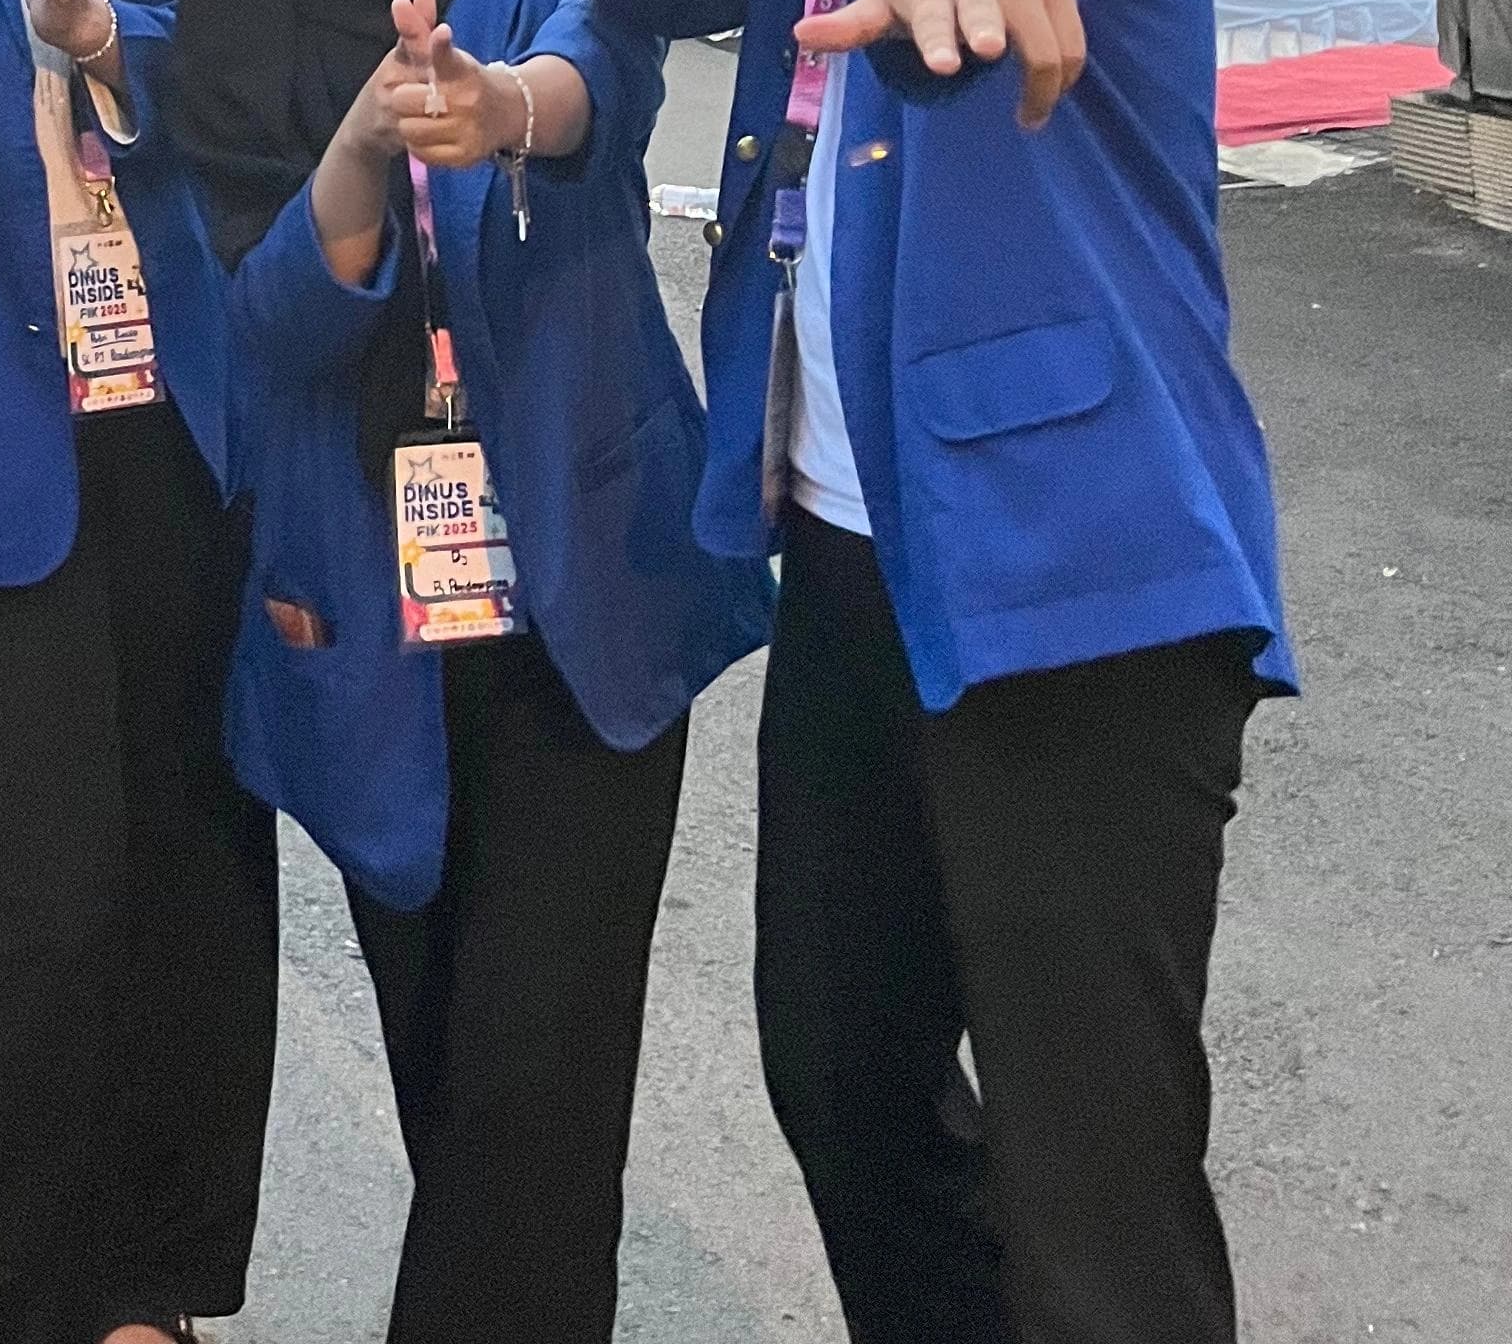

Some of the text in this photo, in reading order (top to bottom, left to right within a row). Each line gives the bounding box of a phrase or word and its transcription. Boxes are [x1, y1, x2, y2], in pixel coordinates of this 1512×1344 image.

[69, 267, 119, 288] DINUS
[70, 283, 124, 306] INSIDE
[404, 481, 469, 504] DINUS
[405, 499, 474, 523] INSIDE
[416, 521, 478, 537] FIK 2025
